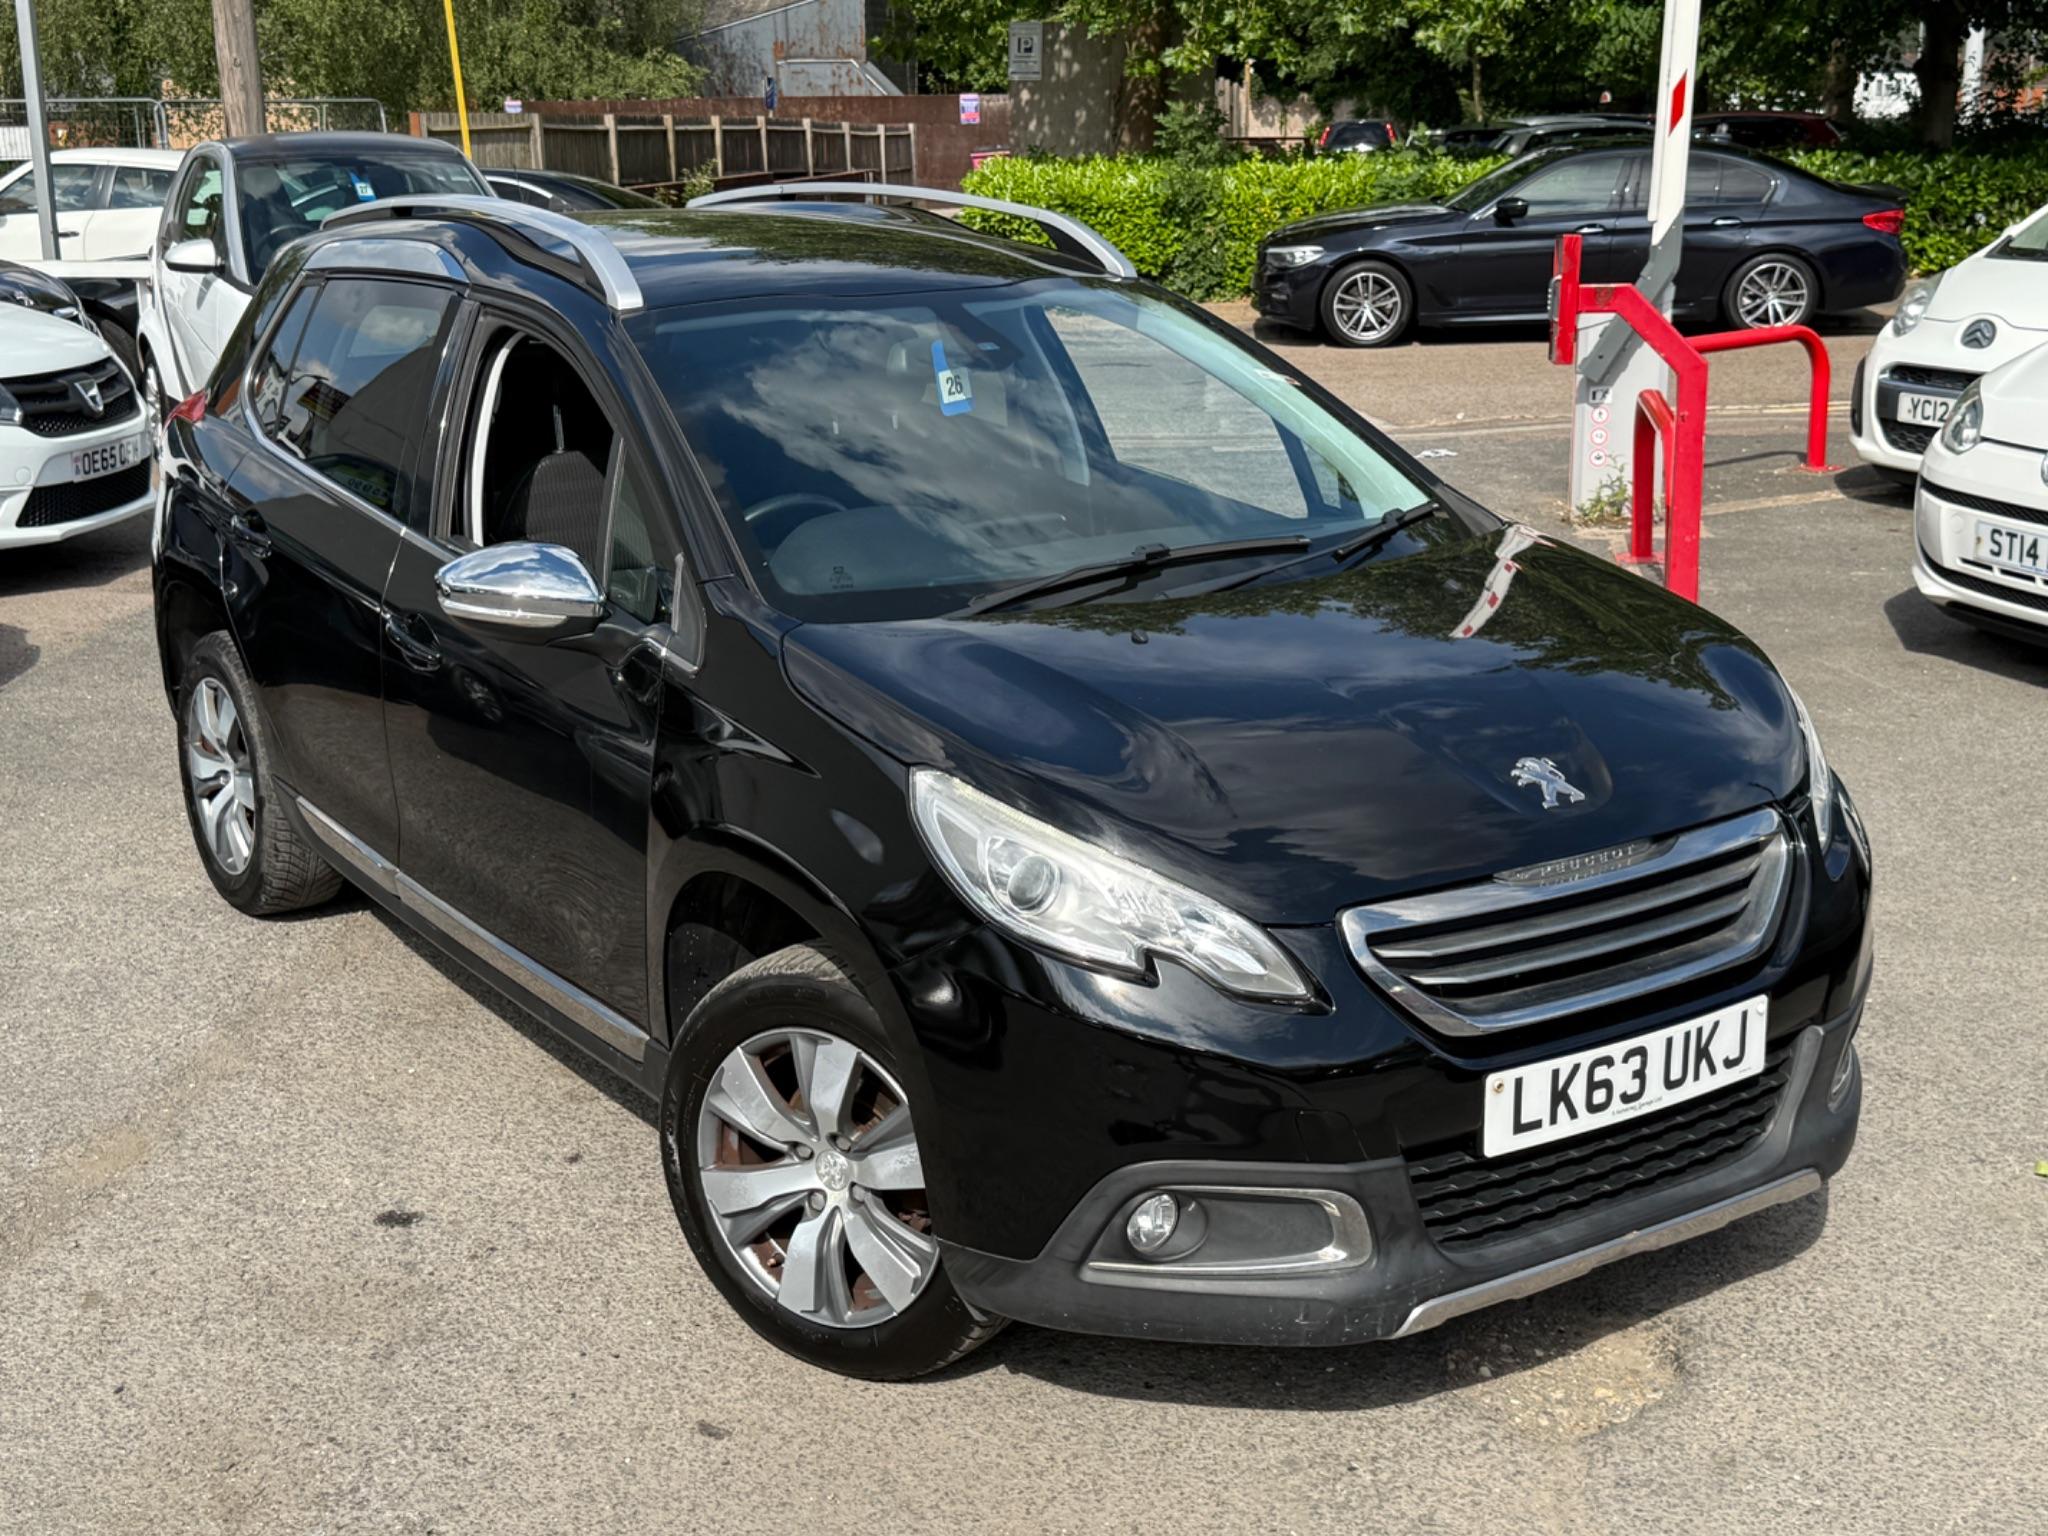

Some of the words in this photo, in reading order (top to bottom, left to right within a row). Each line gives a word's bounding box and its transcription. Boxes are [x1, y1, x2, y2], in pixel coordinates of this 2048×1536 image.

[946, 375, 963, 396] 26
[1911, 397, 1950, 423] YC12
[82, 446, 117, 475] OE65
[1990, 528, 2039, 567] ST14
[1539, 844, 1635, 877] PEUGEOT
[1512, 1045, 1648, 1136] LK63
[1663, 1009, 1748, 1091] UKJ
